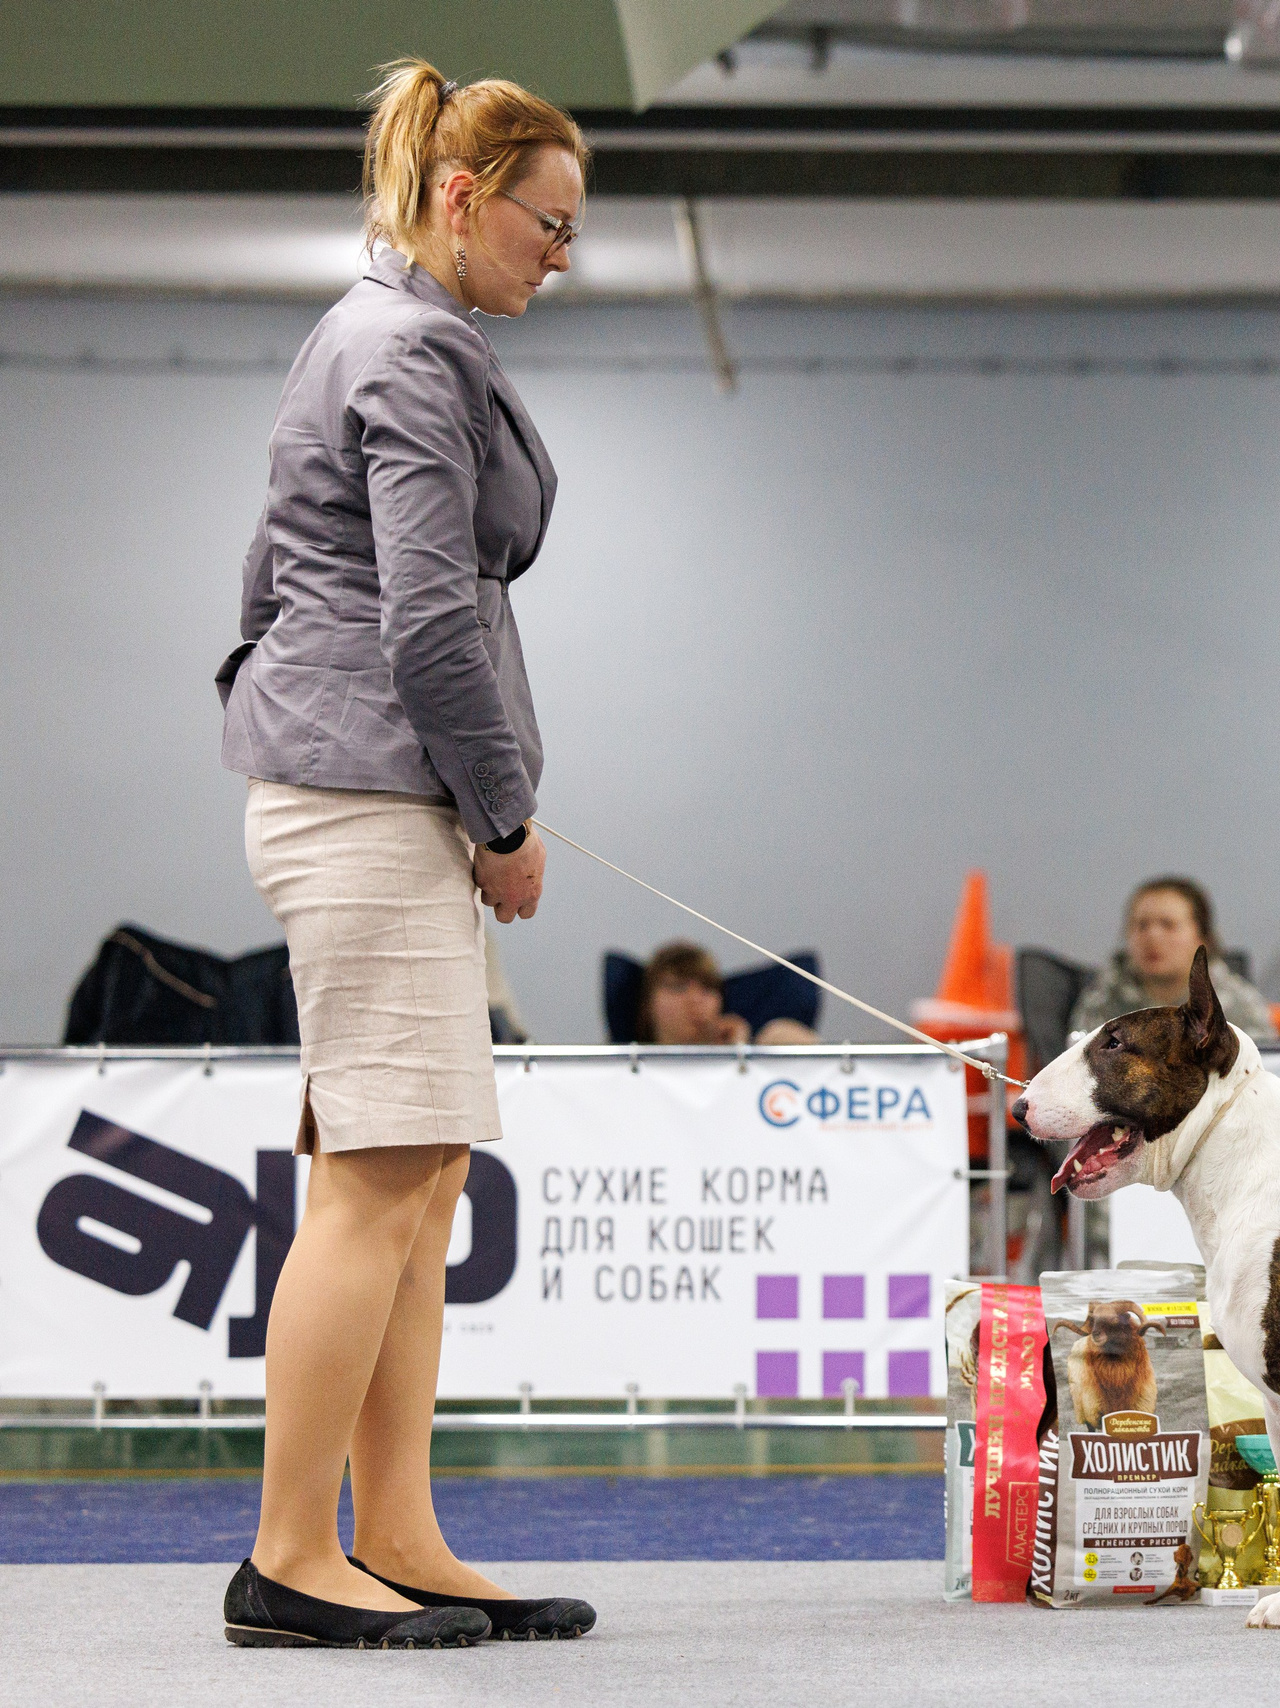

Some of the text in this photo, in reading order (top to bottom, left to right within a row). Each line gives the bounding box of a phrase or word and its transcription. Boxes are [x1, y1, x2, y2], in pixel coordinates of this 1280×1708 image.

[759, 1080, 932, 1128] СФЕРА
[541, 1166, 828, 1204] СУХИЕ КОРМА
[539, 1215, 775, 1258] ДЛЯ КОШЕК
[541, 1264, 722, 1301] И СОБАК
[1020, 1335, 1036, 1391] МКОО
[984, 1414, 1004, 1519] ЛУЧШИЙ
[1081, 1438, 1193, 1474] ХОЛИСТИК
[1083, 1485, 1189, 1495] ПОЛНОРАЦИОННЫЙ СУХОЙ КОРМ
[1117, 1473, 1157, 1482] ПРЕМЬЕР
[1012, 1488, 1029, 1561] МАСТЕРС
[1031, 1428, 1060, 1594] ХОЛИСТИК
[1082, 1520, 1188, 1535] СРЕДНИХ И КРУПНЫХ ПОРОД
[1094, 1506, 1179, 1520] ДЛЯ ВЗРОСЛЫХ СОБАК
[1140, 1538, 1145, 1546] С
[1149, 1537, 1179, 1545] РИСОМ
